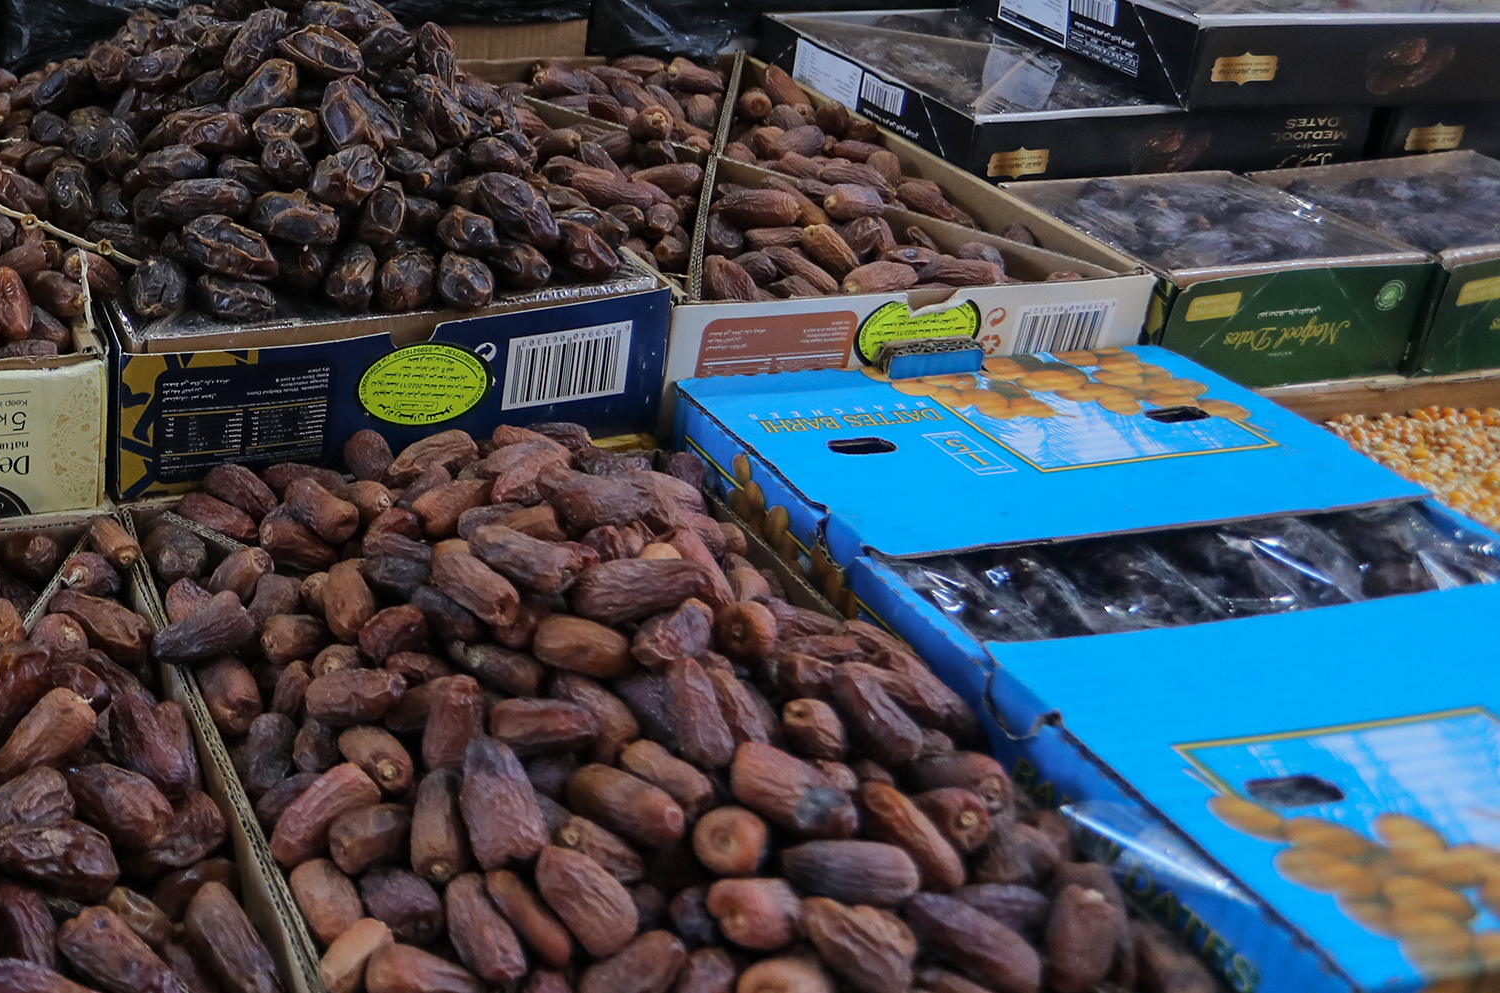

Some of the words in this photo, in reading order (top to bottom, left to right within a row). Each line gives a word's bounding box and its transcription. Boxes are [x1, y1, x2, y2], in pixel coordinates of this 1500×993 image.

[1285, 117, 1340, 129] DATES
[1271, 130, 1347, 142] MEDJOOL
[1223, 327, 1276, 352] Dates
[1279, 316, 1350, 349] Medjool
[4, 399, 28, 410] Keep
[11, 411, 27, 432] 5
[757, 415, 841, 434] BARHI
[842, 407, 945, 428] DATTES
[945, 438, 970, 452] 5
